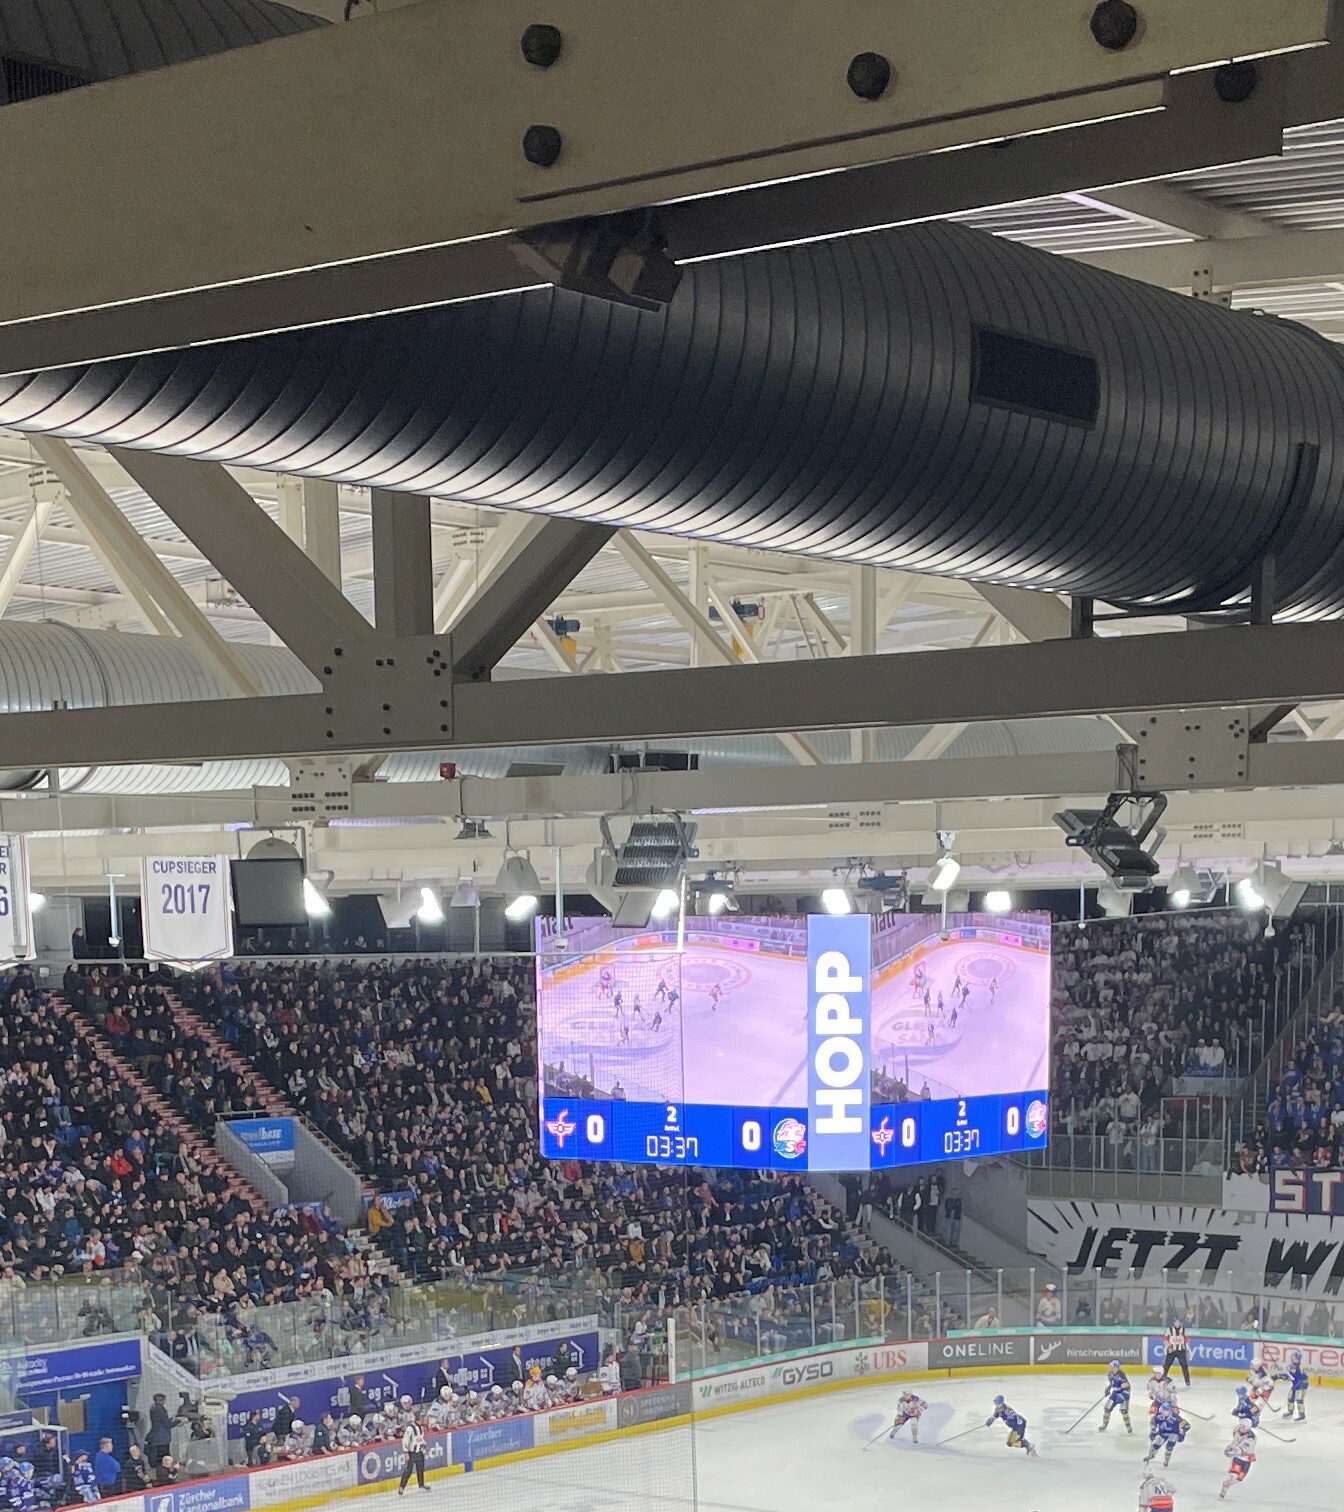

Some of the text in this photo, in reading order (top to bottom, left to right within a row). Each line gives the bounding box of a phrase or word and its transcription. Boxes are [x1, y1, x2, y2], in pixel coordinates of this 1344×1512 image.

[153, 861, 216, 874] CUPSIEGER
[162, 884, 210, 914] 2017
[815, 951, 863, 1134] HOPP
[666, 1107, 677, 1122] 2
[958, 1101, 966, 1116] 2
[586, 1115, 604, 1143] 0
[1006, 1107, 1018, 1135] 0
[741, 1121, 760, 1150] 0
[902, 1118, 915, 1147] 0
[944, 1128, 979, 1154] 03:37
[646, 1135, 698, 1159] 03:37
[773, 1140, 807, 1154] ZSC
[1066, 1226, 1241, 1287] JETZT
[943, 1341, 1013, 1357] ONELINE
[1067, 1347, 1139, 1358] hirschruckstuhl
[873, 1350, 907, 1369] UBS
[783, 1361, 833, 1385] GYSO
[368, 1387, 382, 1401] ag
[714, 1382, 739, 1396] WITZIG
[261, 1407, 276, 1422] ag
[179, 1487, 216, 1504] Zürcher
